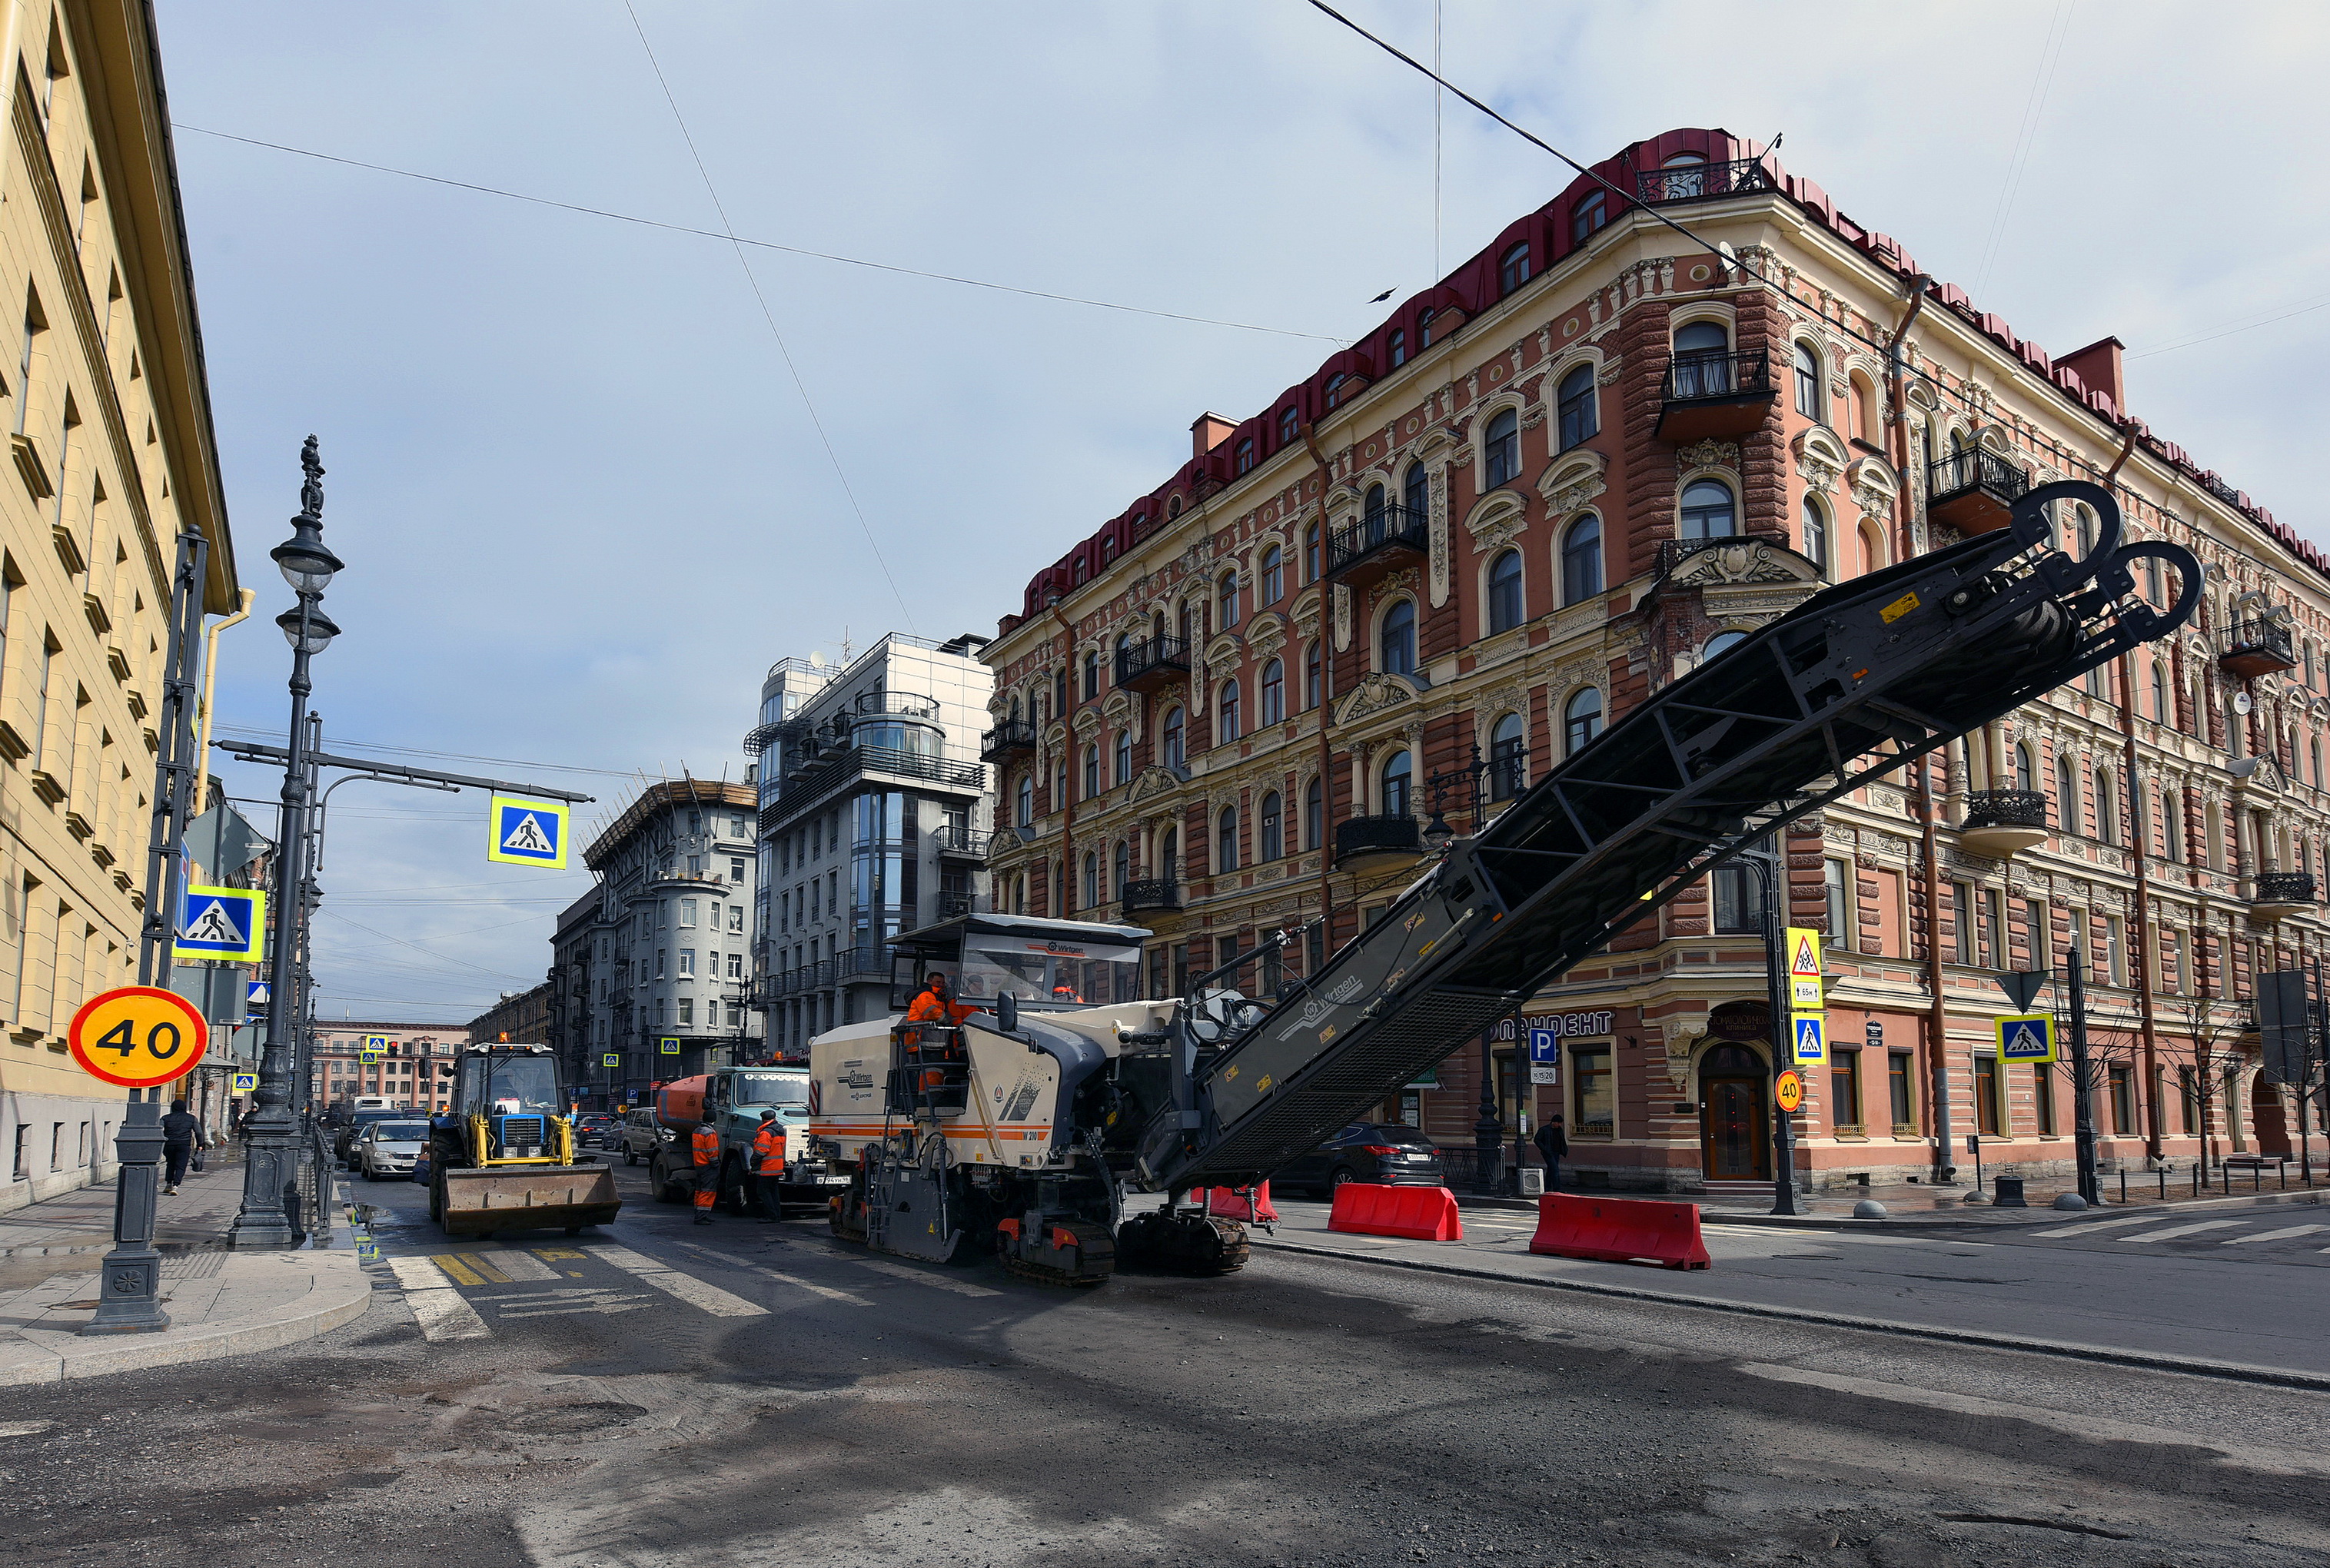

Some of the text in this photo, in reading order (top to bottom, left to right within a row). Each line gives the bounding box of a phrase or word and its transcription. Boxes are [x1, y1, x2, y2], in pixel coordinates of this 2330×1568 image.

[1059, 945, 1083, 953] Wirtgen
[1318, 975, 1357, 1008] Wirtgen
[1802, 988, 1813, 996] 65м
[95, 1019, 181, 1060] 40
[1537, 1032, 1551, 1058] P
[1545, 1071, 1553, 1080] 20
[1782, 1082, 1797, 1099] 40
[1029, 1131, 1037, 1141] 210
